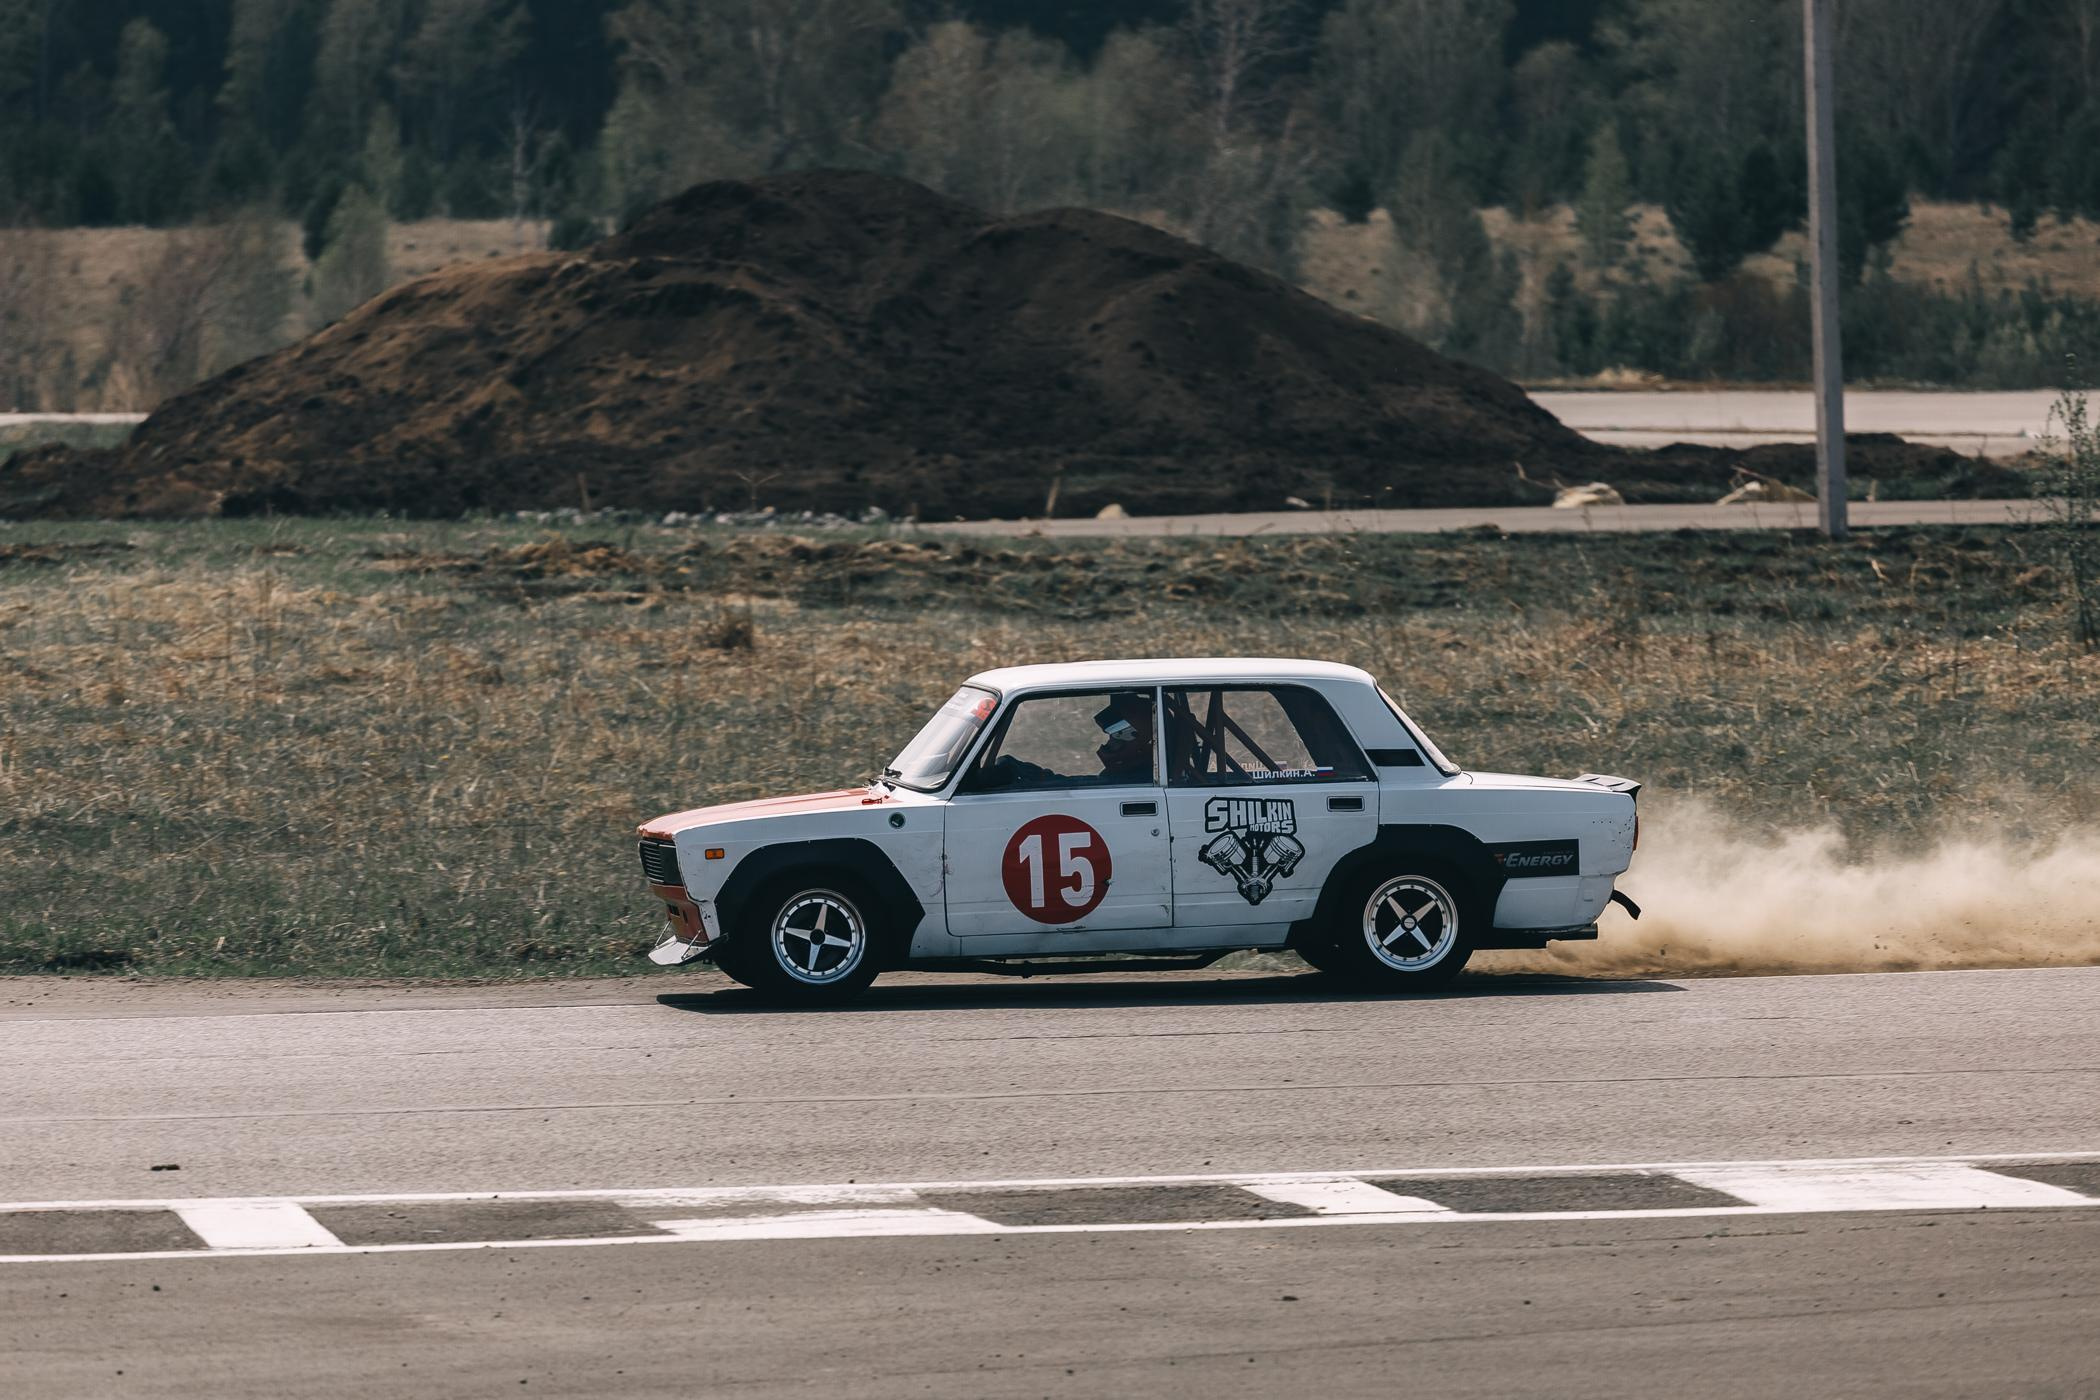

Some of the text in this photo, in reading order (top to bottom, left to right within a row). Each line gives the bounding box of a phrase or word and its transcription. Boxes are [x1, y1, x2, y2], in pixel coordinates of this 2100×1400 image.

[1207, 800, 1292, 830] SHILKIN
[1250, 819, 1294, 834] MOTORS
[1019, 831, 1095, 908] 15
